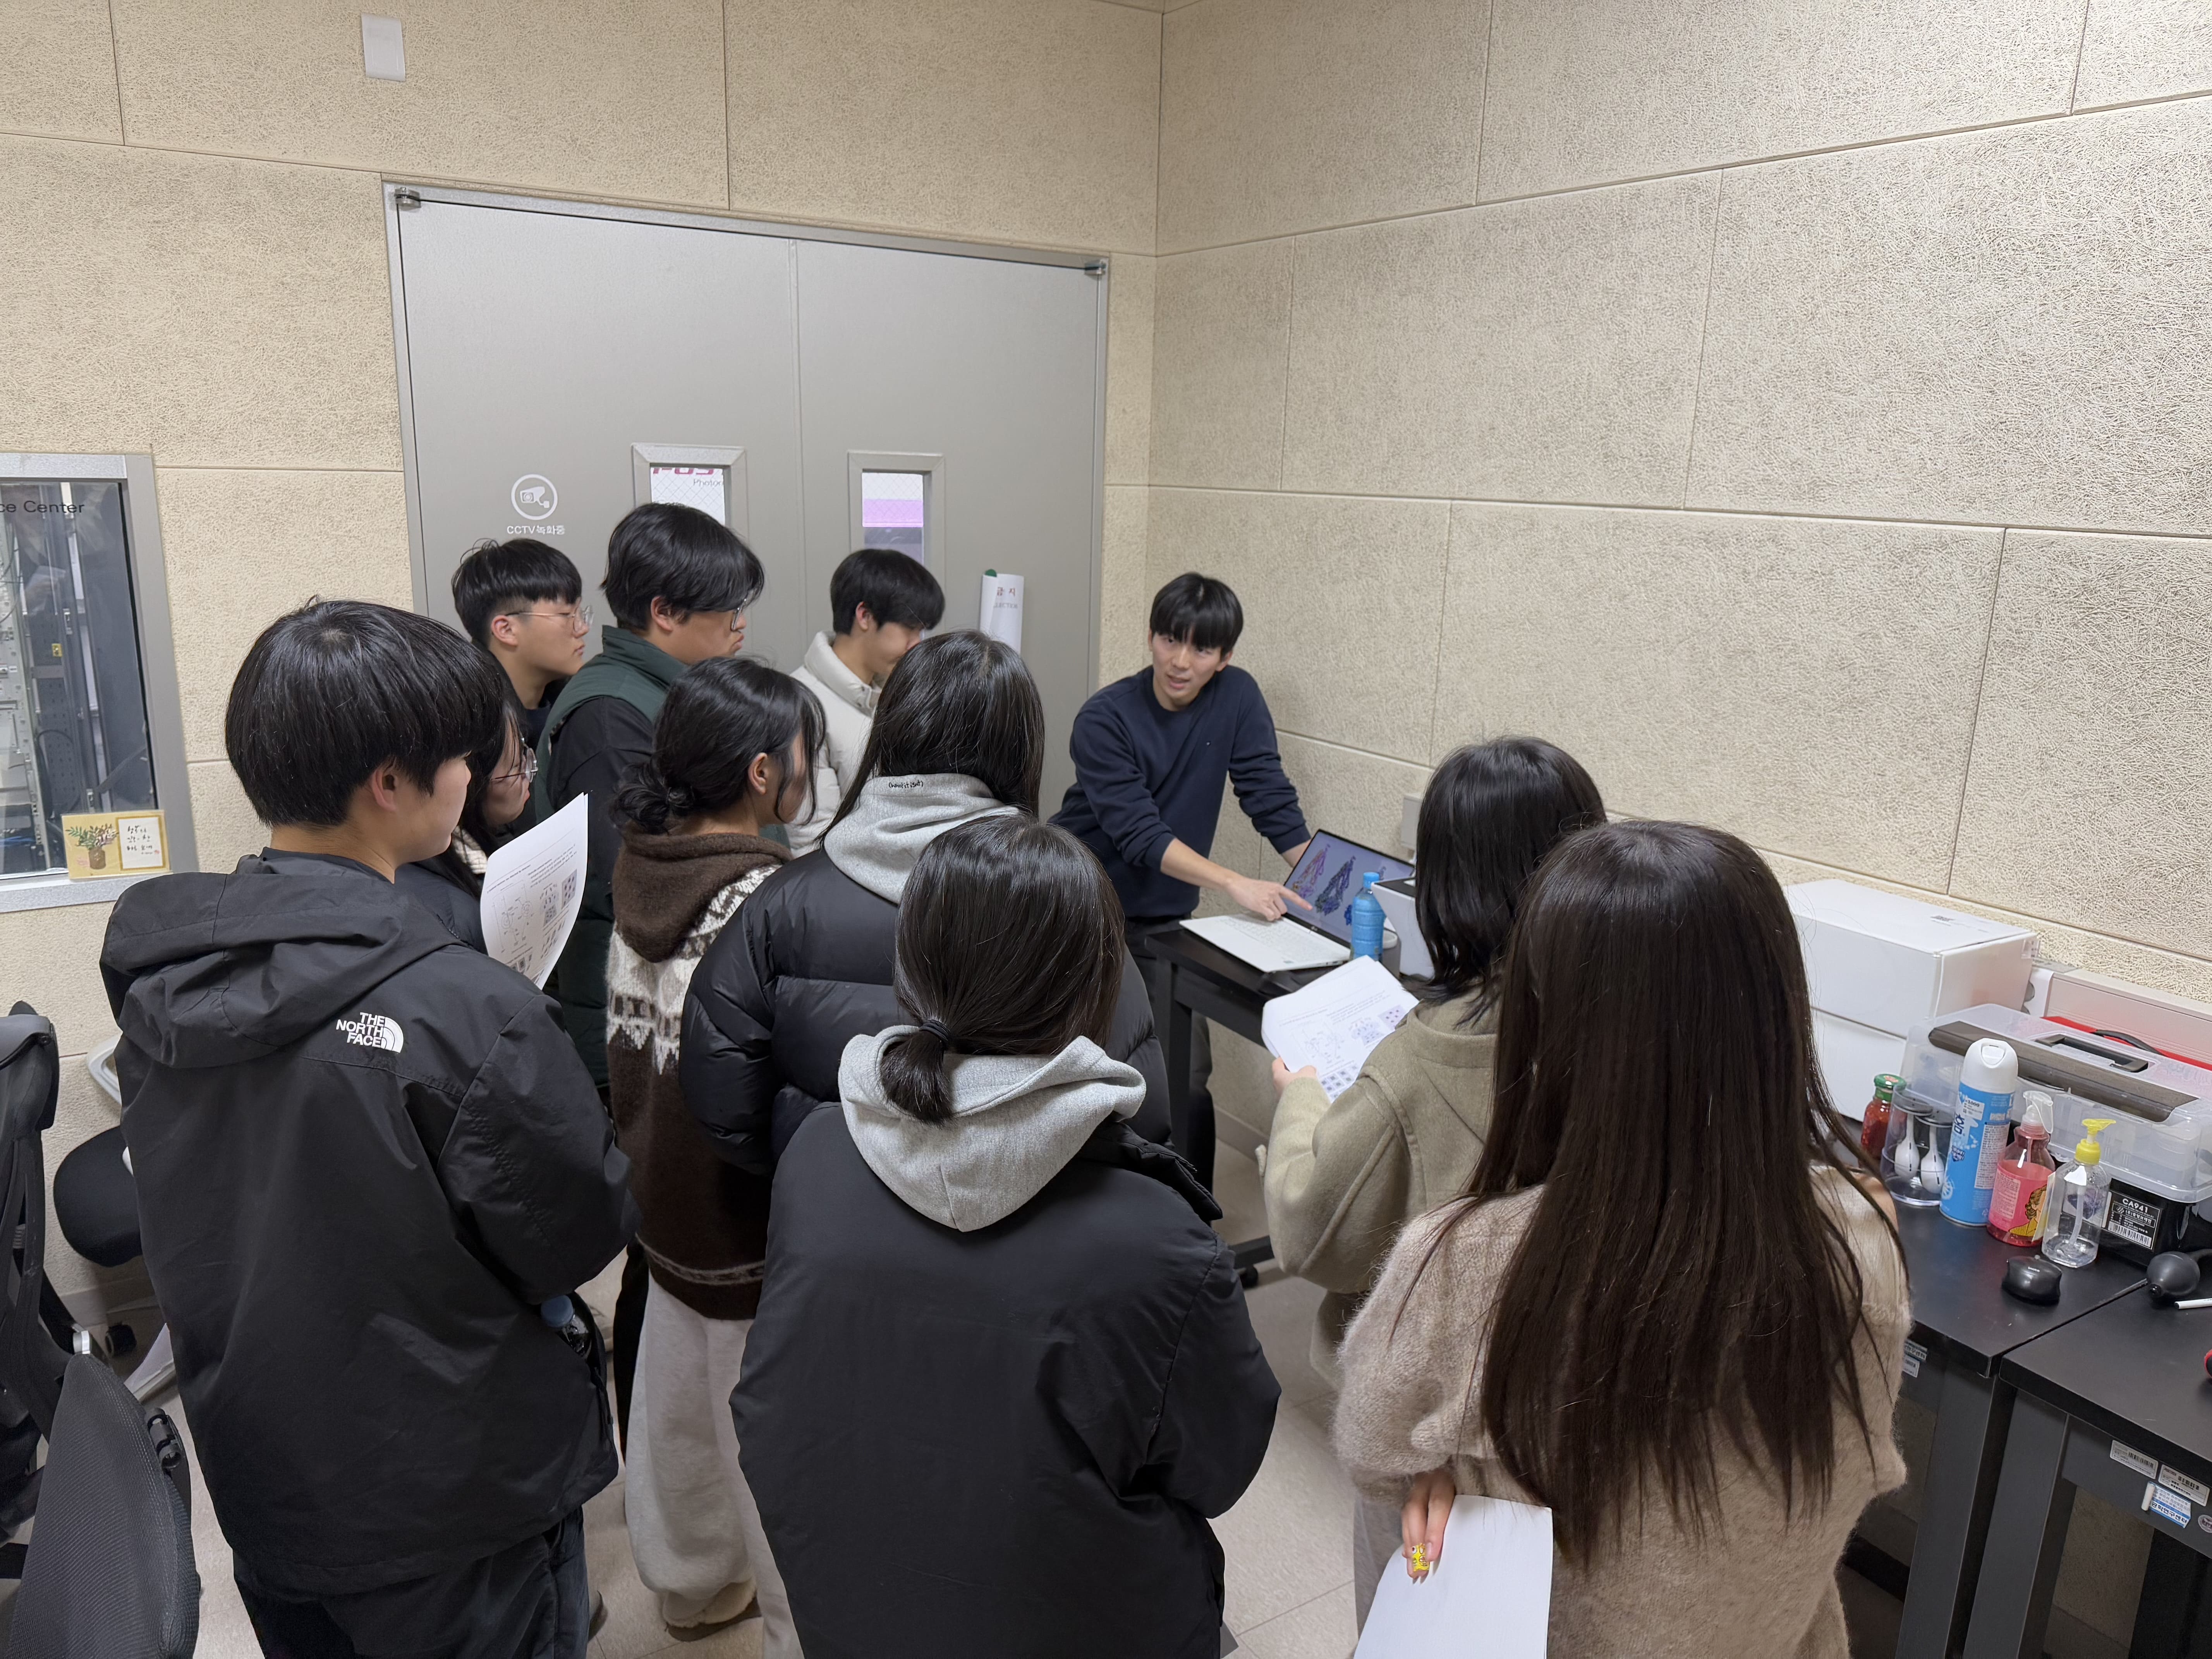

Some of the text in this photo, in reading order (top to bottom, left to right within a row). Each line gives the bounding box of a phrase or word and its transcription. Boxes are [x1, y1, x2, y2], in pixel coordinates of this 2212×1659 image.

[24, 500, 85, 513] Center
[360, 1012, 385, 1027] THE
[336, 1019, 384, 1037] NORTH
[347, 1032, 382, 1048] FACE
[2122, 1198, 2148, 1213] CA941
